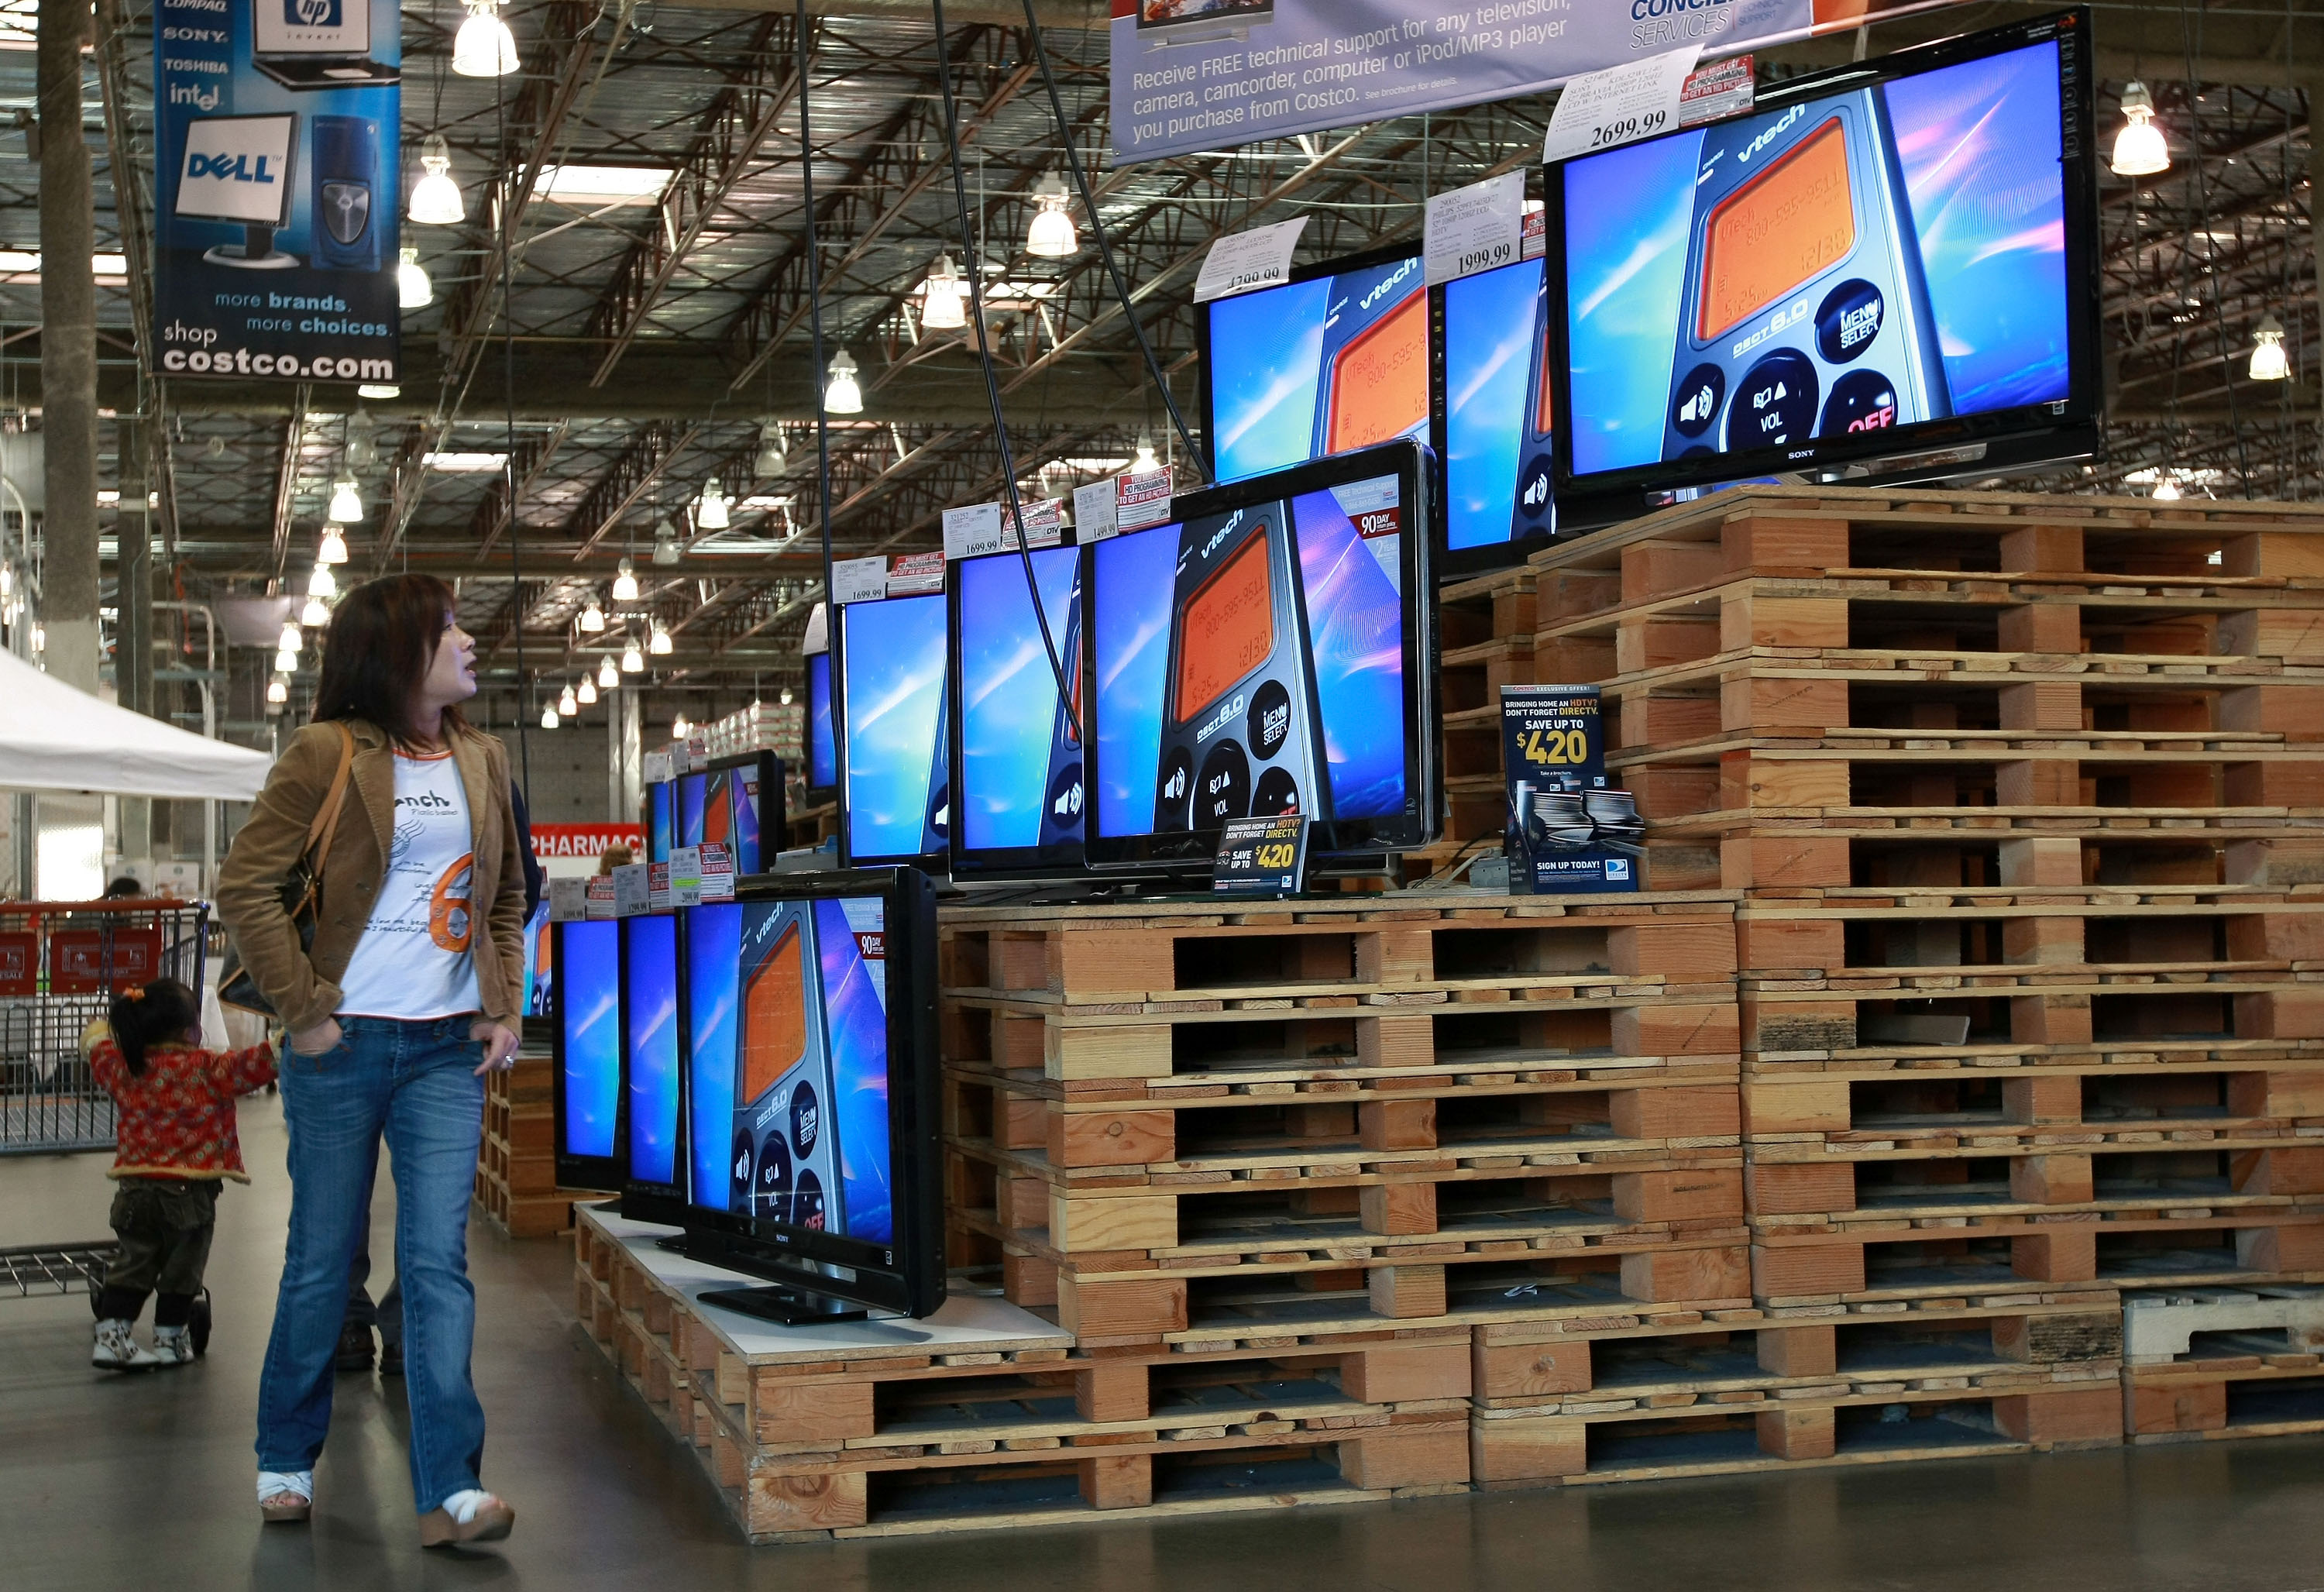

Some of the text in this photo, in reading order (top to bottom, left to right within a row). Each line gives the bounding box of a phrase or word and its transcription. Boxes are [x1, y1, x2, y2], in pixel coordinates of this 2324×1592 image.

[163, 27, 226, 43] SONY
[1630, 9, 1730, 49] SERVICES
[1133, 63, 1197, 91] Receive
[1202, 54, 1243, 78] FREE
[1247, 38, 1329, 68] technical
[1334, 23, 1398, 57] support
[1403, 19, 1427, 40] for
[1435, 12, 1470, 36] any
[163, 58, 229, 74] TOSHIBA
[1133, 19, 1568, 115] camera, camcorder, computer or iPod/MP3 player
[170, 82, 219, 112] intel
[1681, 92, 1690, 101] TO
[1690, 88, 1701, 98] GET
[1133, 122, 1164, 145] you
[1167, 106, 1244, 139] purchase
[1249, 98, 1289, 122] from
[1294, 86, 1360, 112] Costco.
[1380, 83, 1416, 99] brochure
[1417, 81, 1430, 92] for
[1590, 109, 1666, 148] 2699.99
[1738, 103, 1806, 163] vtech
[187, 152, 274, 184] DELL
[1458, 242, 1511, 275] 1999.99
[1360, 256, 1418, 310] vtech
[215, 291, 352, 313] more brands.
[163, 319, 218, 349] shop
[246, 317, 394, 337] more choices.
[1732, 297, 1810, 355] DECT 6.0
[163, 347, 394, 380] costco.com
[1760, 411, 1783, 432] VOL
[1788, 449, 1815, 460] SONY
[1125, 478, 1167, 494] HD PROGRAMMING
[1131, 475, 1143, 483] YOU
[1128, 495, 1139, 504] GET
[1094, 523, 1116, 539] 1499.99
[1201, 508, 1244, 560] vtech
[1361, 513, 1390, 535] 90 DAY
[965, 540, 998, 555] 1699.99
[853, 589, 882, 600] 1699.99
[1197, 694, 1244, 741] DECT 6.0
[1559, 707, 1599, 716] DIRECTV.
[1525, 719, 1584, 730] SAVE UP TO
[1516, 730, 1588, 765] $420
[1214, 799, 1229, 817] VOL
[1277, 818, 1301, 828] HDTV?
[1243, 830, 1265, 838] FORGET
[1231, 860, 1250, 868] UP TO
[1232, 850, 1253, 860] SAVE
[1537, 861, 1556, 870] SIGN
[1570, 860, 1600, 869] TODAY!
[755, 901, 783, 944] vtech
[861, 935, 882, 954] 90 DAY
[771, 1088, 788, 1111] 6.0
